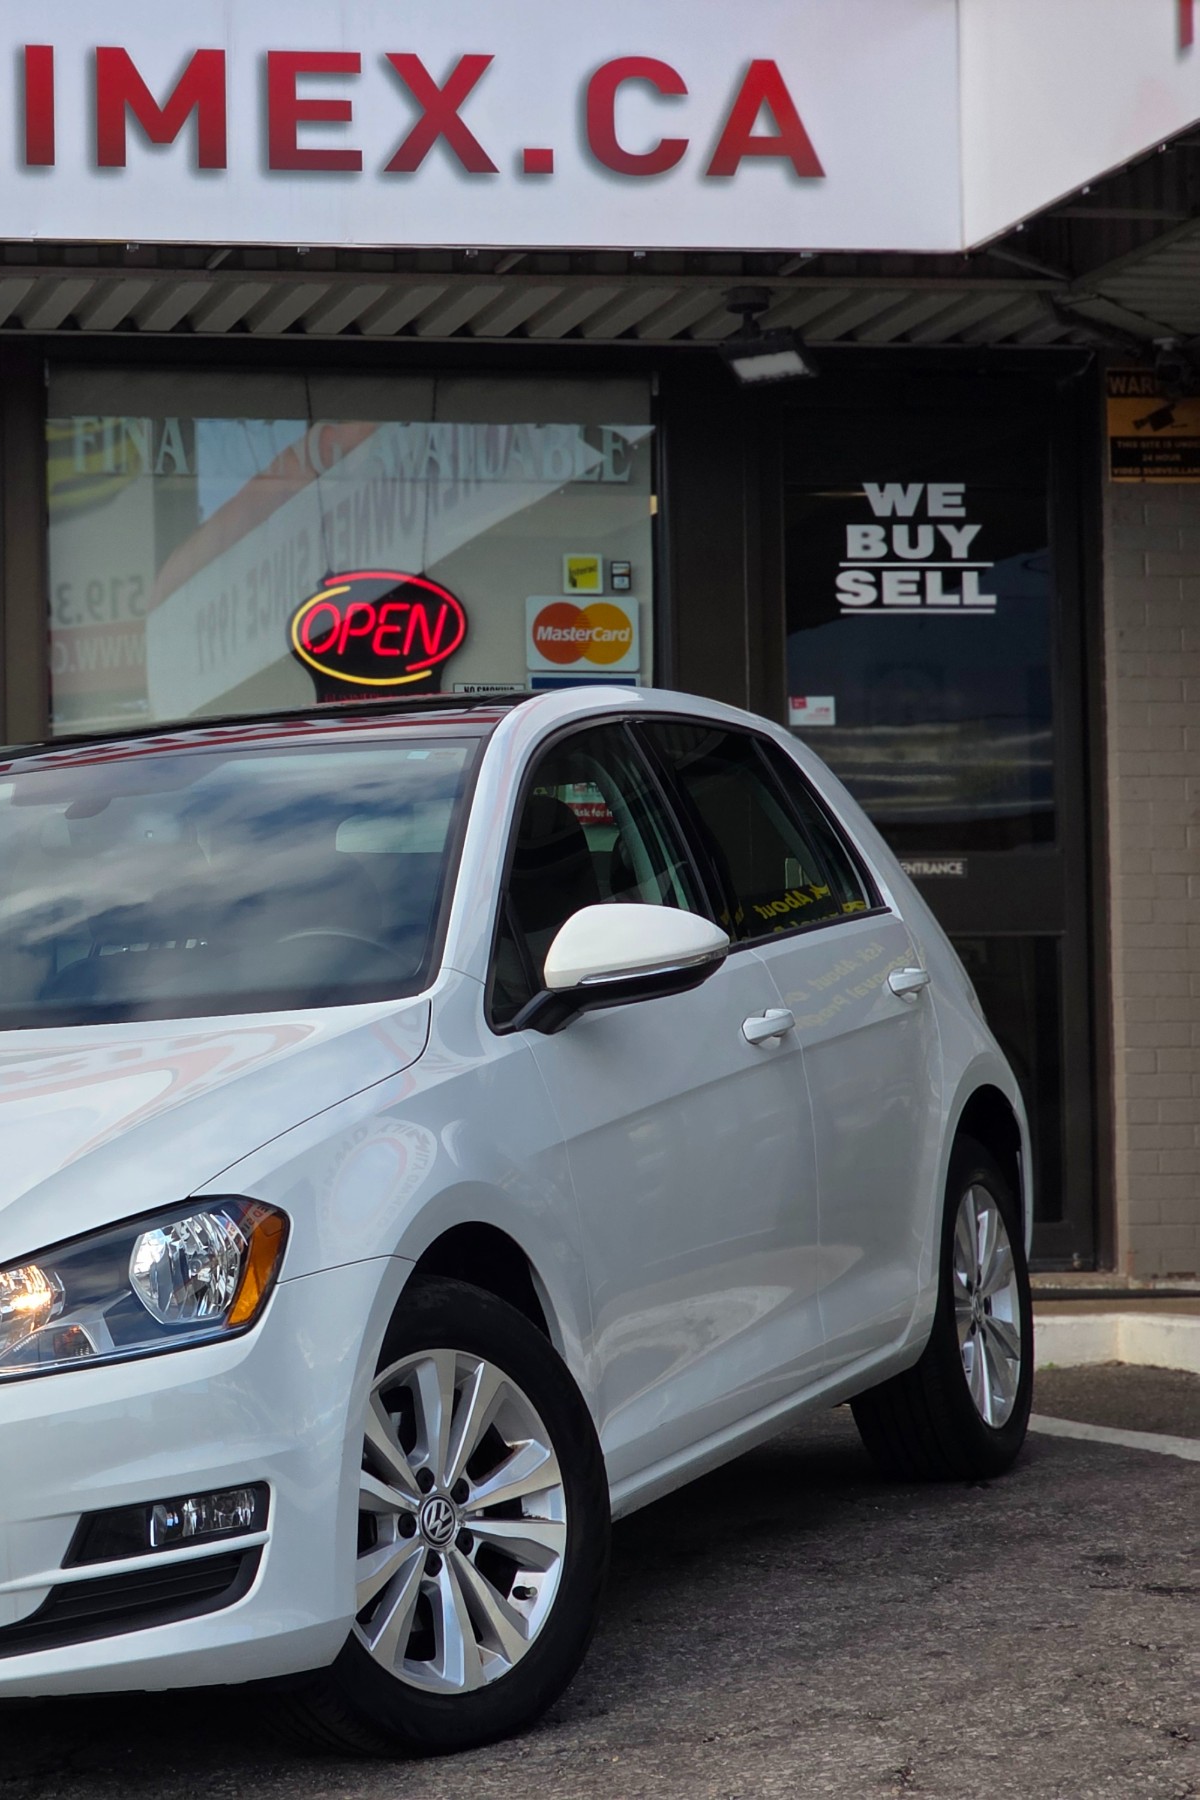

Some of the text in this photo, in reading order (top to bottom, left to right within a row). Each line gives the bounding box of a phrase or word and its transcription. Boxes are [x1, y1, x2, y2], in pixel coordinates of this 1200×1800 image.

[862, 482, 966, 517] WE
[846, 524, 982, 559] BUY
[835, 570, 997, 606] SELL
[301, 602, 449, 656] OPEN
[536, 625, 631, 642] MasterCard
